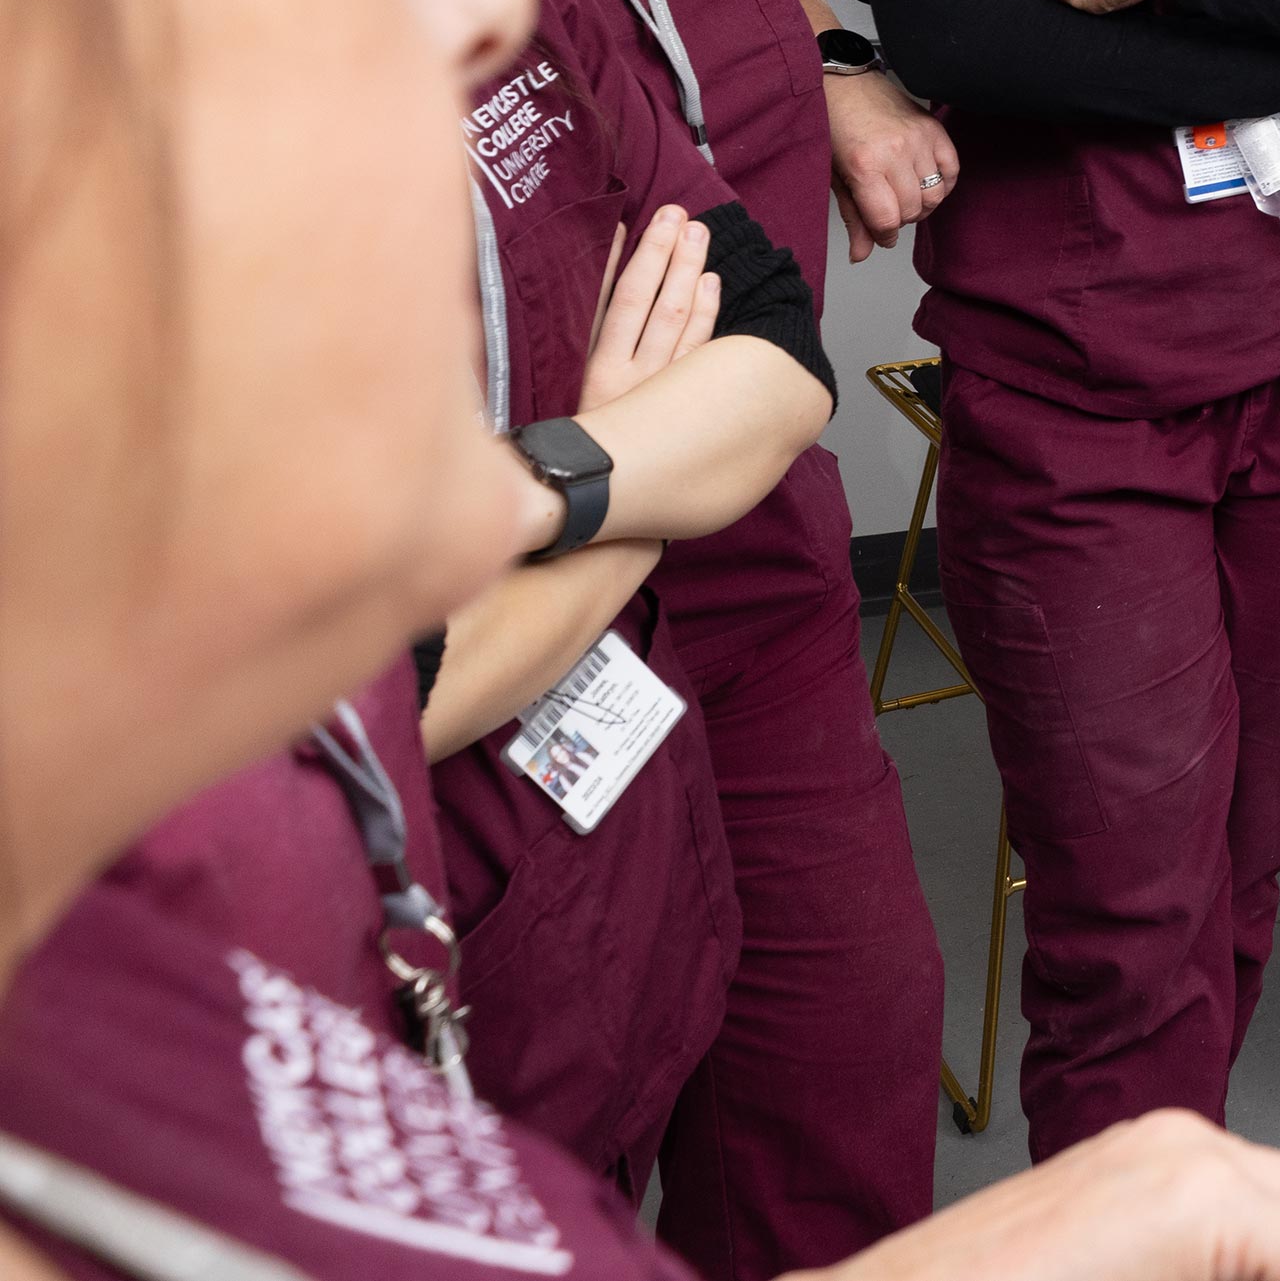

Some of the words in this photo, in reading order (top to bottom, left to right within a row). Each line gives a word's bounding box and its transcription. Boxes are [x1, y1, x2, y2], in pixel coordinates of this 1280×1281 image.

[462, 61, 560, 139] NEWCASTLE
[476, 100, 543, 158] COLLEGE
[492, 109, 575, 181] UNIVERSITY
